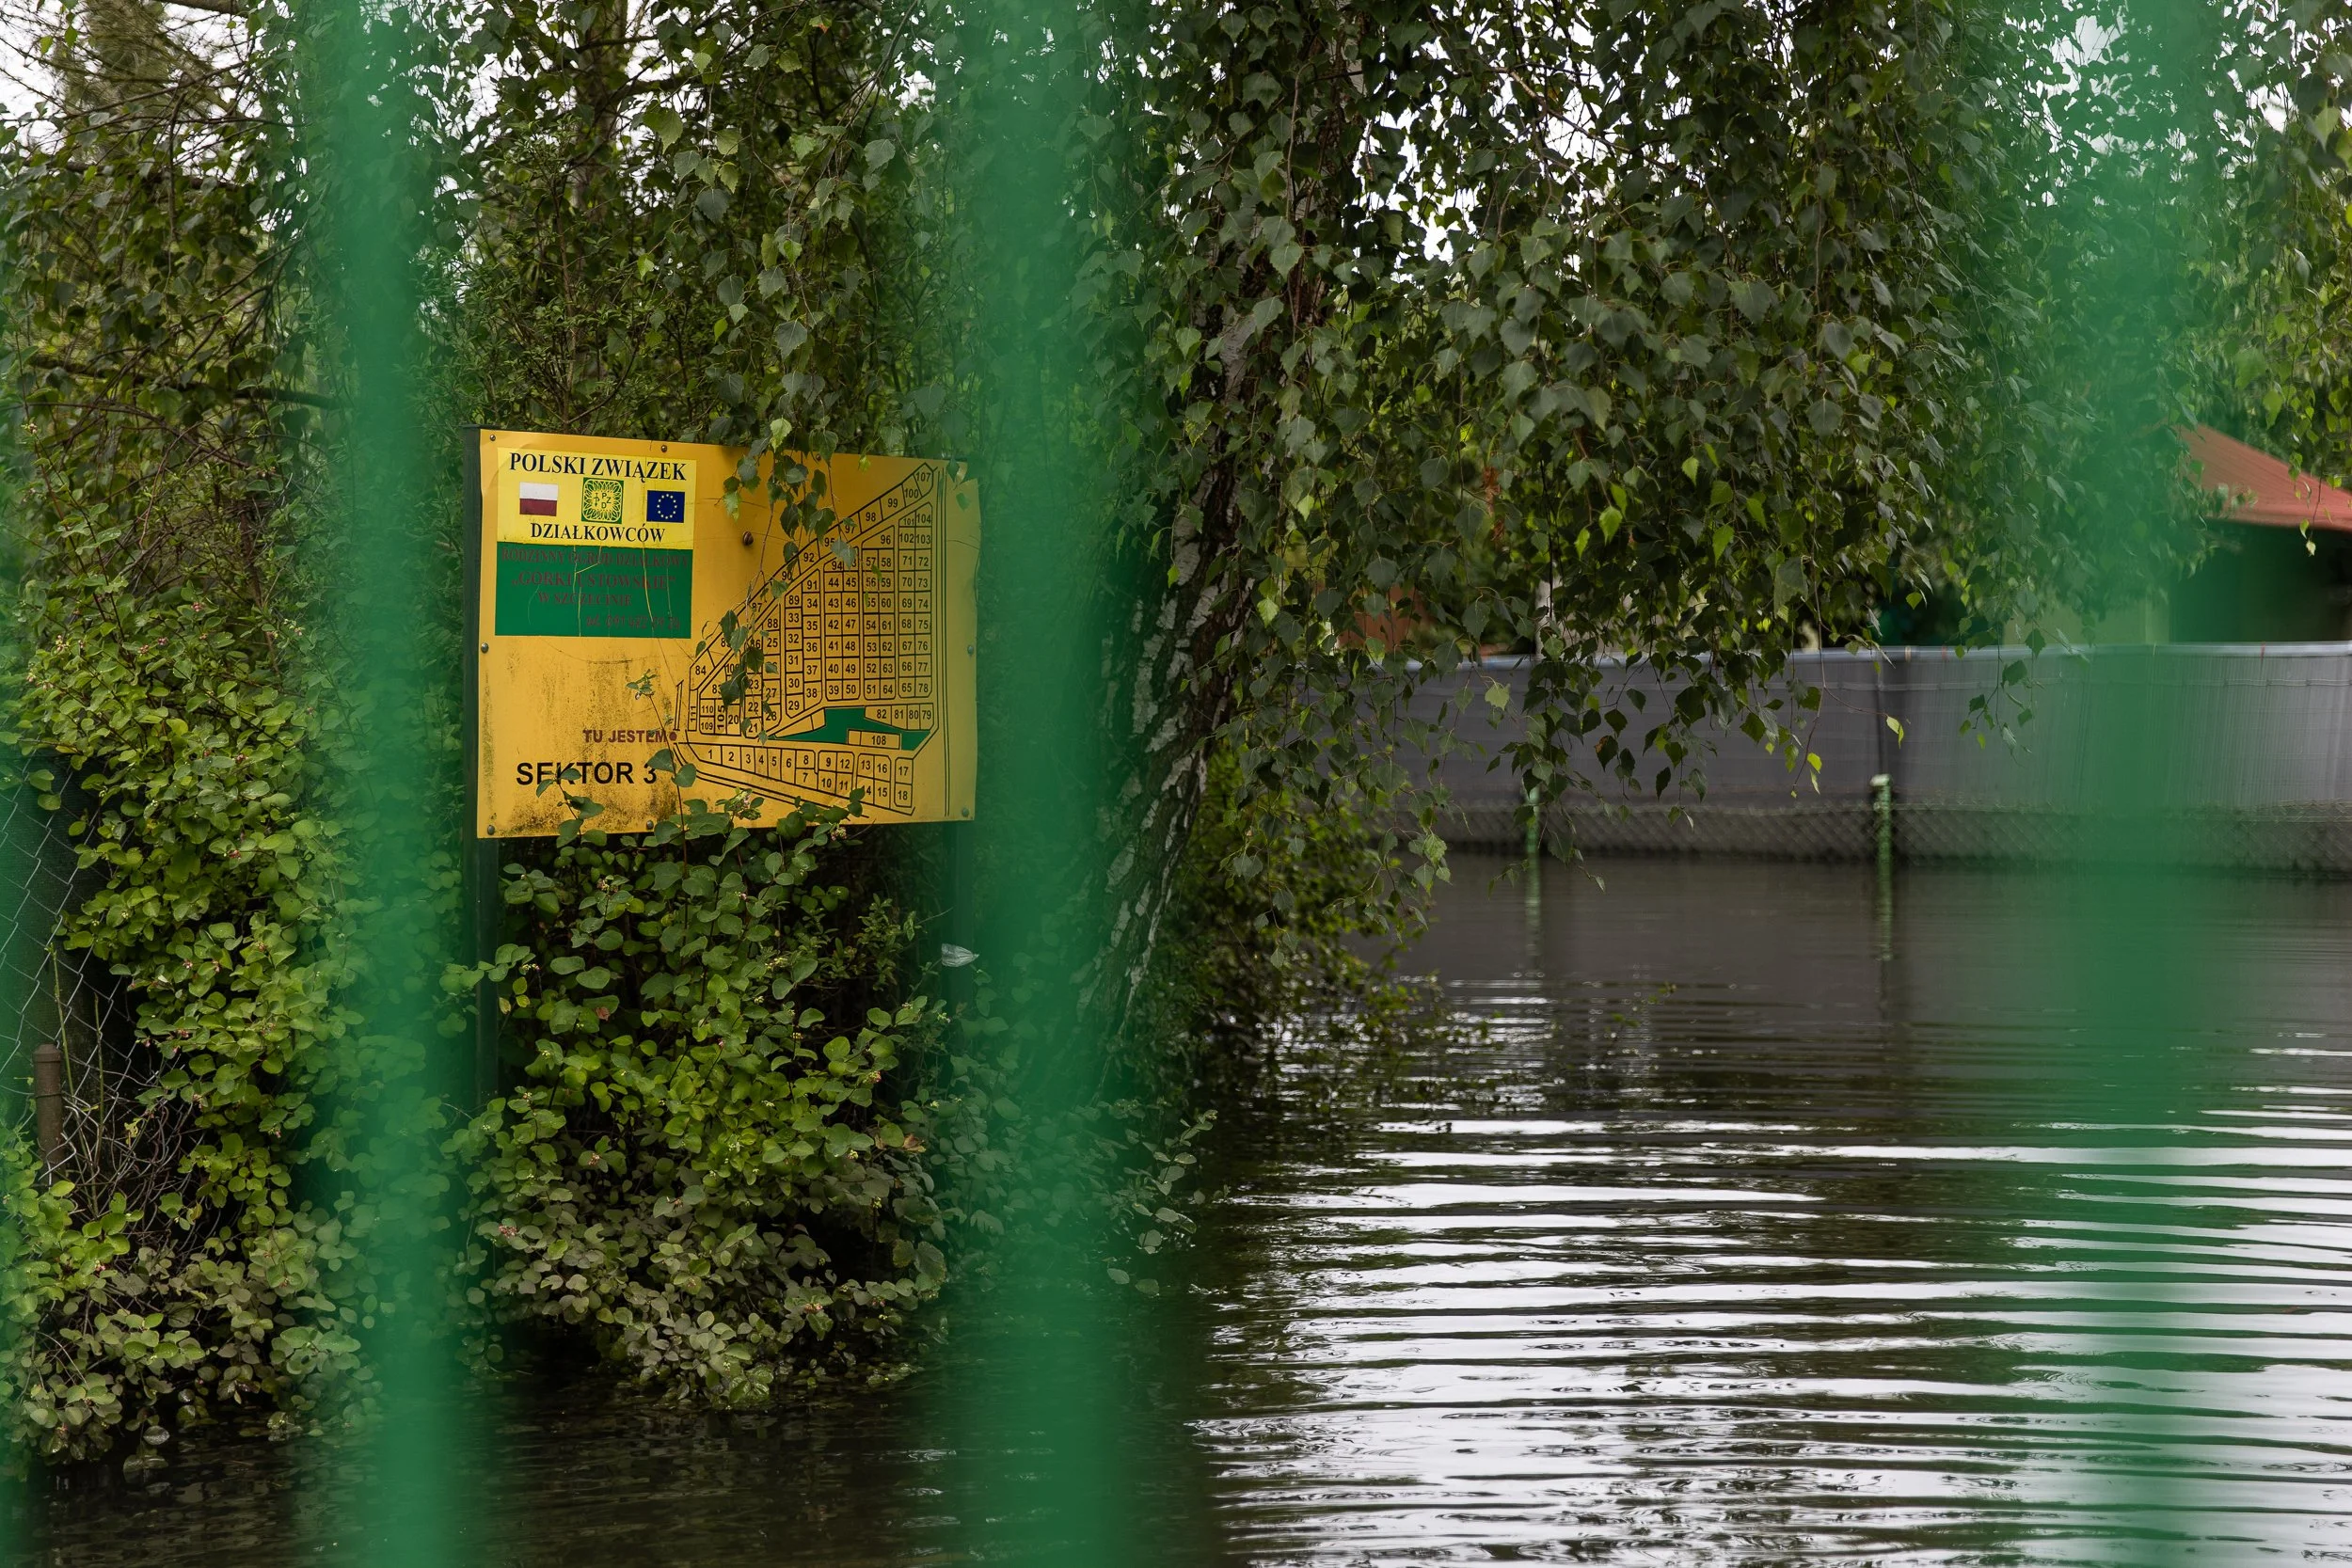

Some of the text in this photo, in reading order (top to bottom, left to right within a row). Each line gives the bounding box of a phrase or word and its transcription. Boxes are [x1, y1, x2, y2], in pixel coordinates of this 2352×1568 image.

[510, 452, 687, 483] POLSKI ZWIĄZEK
[916, 472, 930, 482] 107
[905, 489, 919, 498] 100
[888, 499, 898, 507] 99
[866, 512, 876, 521] 98
[917, 514, 931, 523] 104
[531, 523, 665, 543] DZIAŁKOWCÓW
[900, 533, 914, 542] 102
[881, 535, 891, 544] 96
[917, 535, 930, 544] 103
[804, 553, 814, 562] 92
[866, 557, 876, 566] 57
[903, 556, 912, 565] 71
[918, 557, 928, 566] 72
[832, 561, 842, 570] 94
[882, 558, 891, 567] 58
[782, 571, 791, 581] 90
[807, 580, 817, 589] 91
[829, 578, 839, 587] 44
[846, 578, 856, 587] 45
[866, 578, 876, 586] 56
[882, 578, 891, 587] 59
[903, 577, 912, 586] 70
[918, 578, 928, 588] 73
[789, 595, 799, 605] 89
[807, 599, 818, 608] 34
[828, 599, 839, 608] 43
[846, 598, 856, 607] 46
[882, 599, 891, 607] 60
[902, 599, 912, 608] 69
[918, 599, 928, 608] 74
[788, 613, 799, 622] 33
[768, 619, 778, 628] 88
[807, 621, 818, 630] 35
[828, 620, 838, 629] 42
[845, 620, 855, 628] 47
[866, 621, 876, 630] 54
[882, 621, 891, 630] 61
[902, 619, 911, 628] 68
[919, 620, 928, 629] 75
[767, 638, 778, 647] 25
[788, 634, 799, 643] 32
[806, 642, 817, 652] 36
[829, 641, 838, 650] 41
[845, 641, 855, 651] 48
[867, 643, 876, 652] 53
[882, 642, 892, 651] 62
[903, 641, 912, 650] 67
[918, 641, 928, 650] 76
[788, 655, 798, 665] 31
[695, 666, 706, 675] 84
[727, 664, 739, 673] 10
[807, 666, 818, 675] 37
[828, 664, 839, 673] 40
[845, 664, 855, 673] 49
[866, 664, 876, 673] 52
[883, 664, 892, 673] 63
[902, 662, 912, 671] 66
[918, 662, 928, 671] 77
[789, 679, 799, 688] 30
[902, 683, 912, 692] 65
[919, 684, 928, 692] 78
[766, 688, 776, 697] 27
[807, 689, 817, 697] 38
[829, 686, 839, 694] 39
[846, 685, 856, 694] 50
[867, 685, 875, 694] 51
[883, 685, 893, 694] 64
[748, 703, 758, 712] 22
[788, 701, 799, 710] 29
[877, 709, 886, 718] 82
[894, 710, 903, 719] 81
[909, 710, 918, 719] 80
[922, 711, 931, 720] 79
[728, 715, 739, 724] 20
[749, 724, 758, 732] 21
[583, 730, 667, 743] TU JESTEM
[872, 736, 886, 745] 108
[708, 749, 712, 759] 1
[729, 752, 734, 761] 2
[746, 754, 751, 764] 3
[759, 755, 764, 764] 4
[772, 757, 776, 766] 5
[787, 758, 791, 768] 6
[804, 755, 808, 765] 8
[826, 757, 831, 767] 9
[840, 759, 850, 768] 12
[862, 760, 870, 770] 13
[877, 764, 887, 773] 16
[516, 762, 634, 784] SEKTOR
[899, 767, 908, 776] 17
[803, 773, 808, 782] 7
[822, 778, 831, 788] 10
[840, 781, 847, 790] 11
[878, 788, 887, 797] 15
[898, 791, 907, 800] 18
